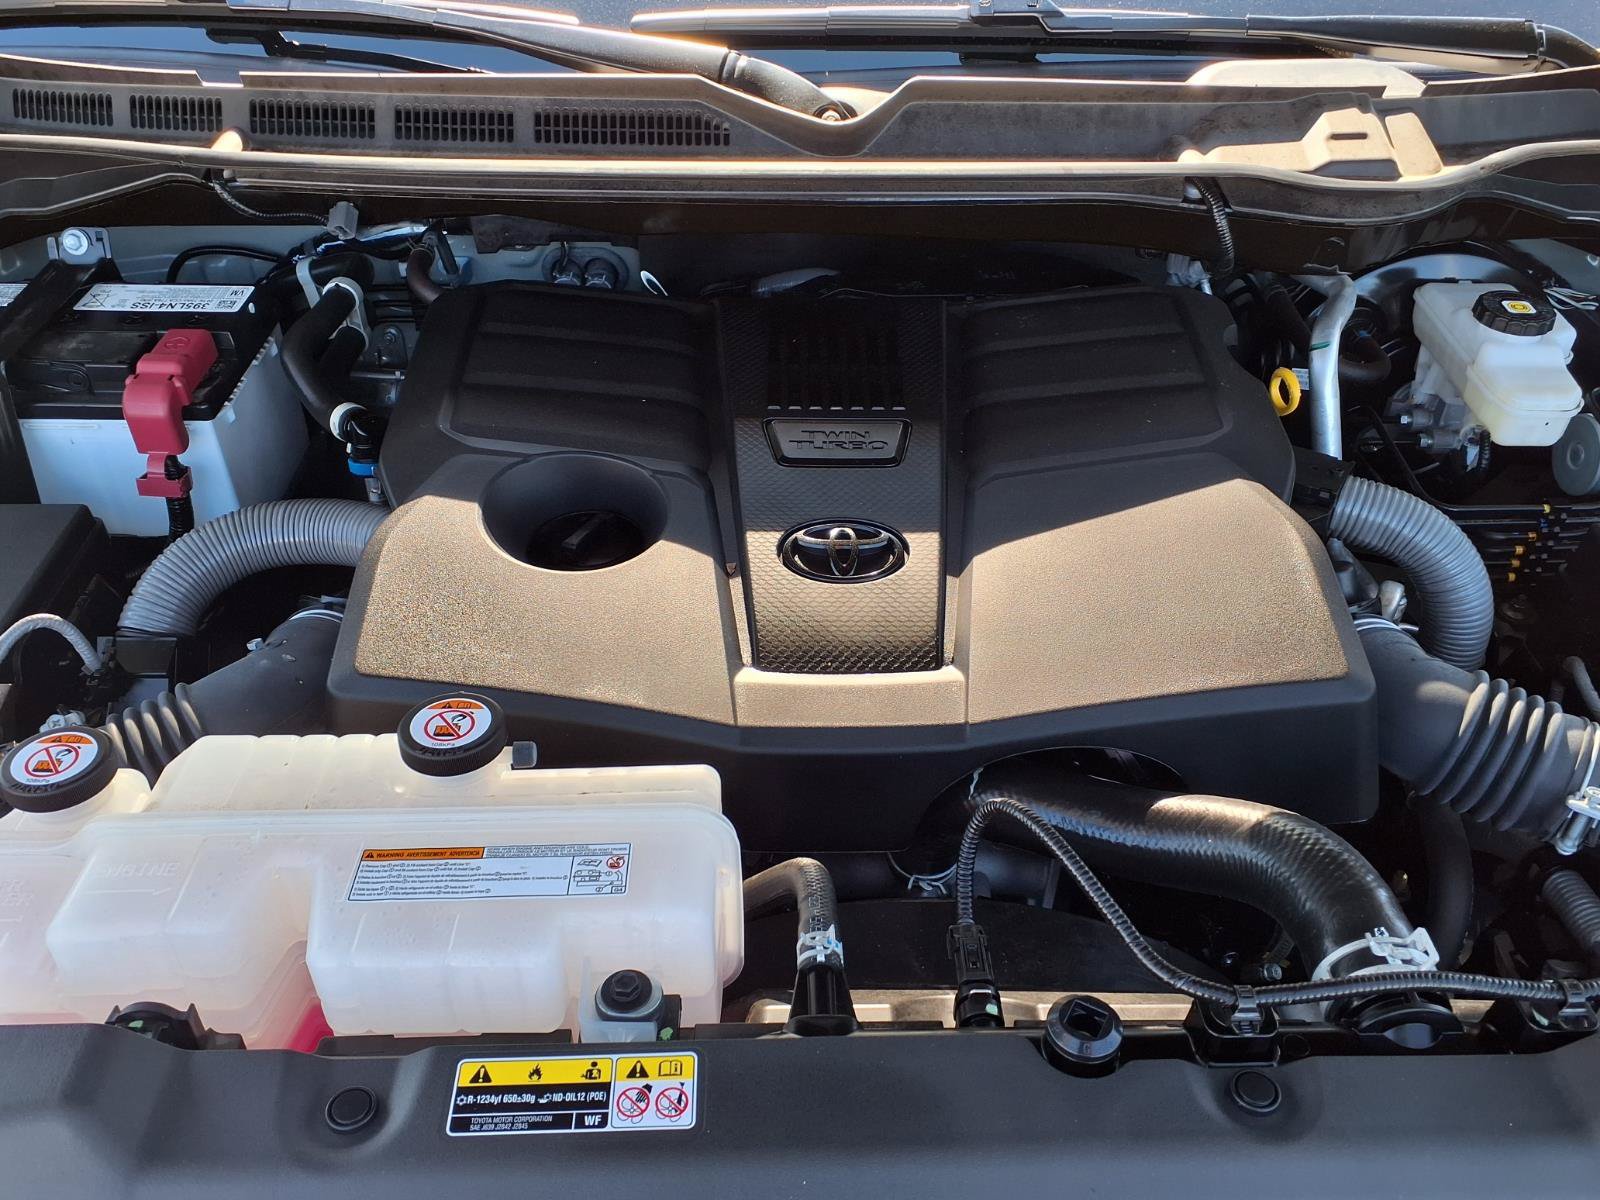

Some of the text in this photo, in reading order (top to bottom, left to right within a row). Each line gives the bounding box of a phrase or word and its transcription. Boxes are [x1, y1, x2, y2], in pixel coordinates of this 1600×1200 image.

[130, 302, 210, 310] 395LN4-ISS
[801, 430, 870, 439] TWIN
[788, 440, 888, 449] TURBO
[467, 1091, 607, 1105] R-1234yf 650±30g ND-OIL12 (POE)
[584, 1115, 602, 1126] WF
